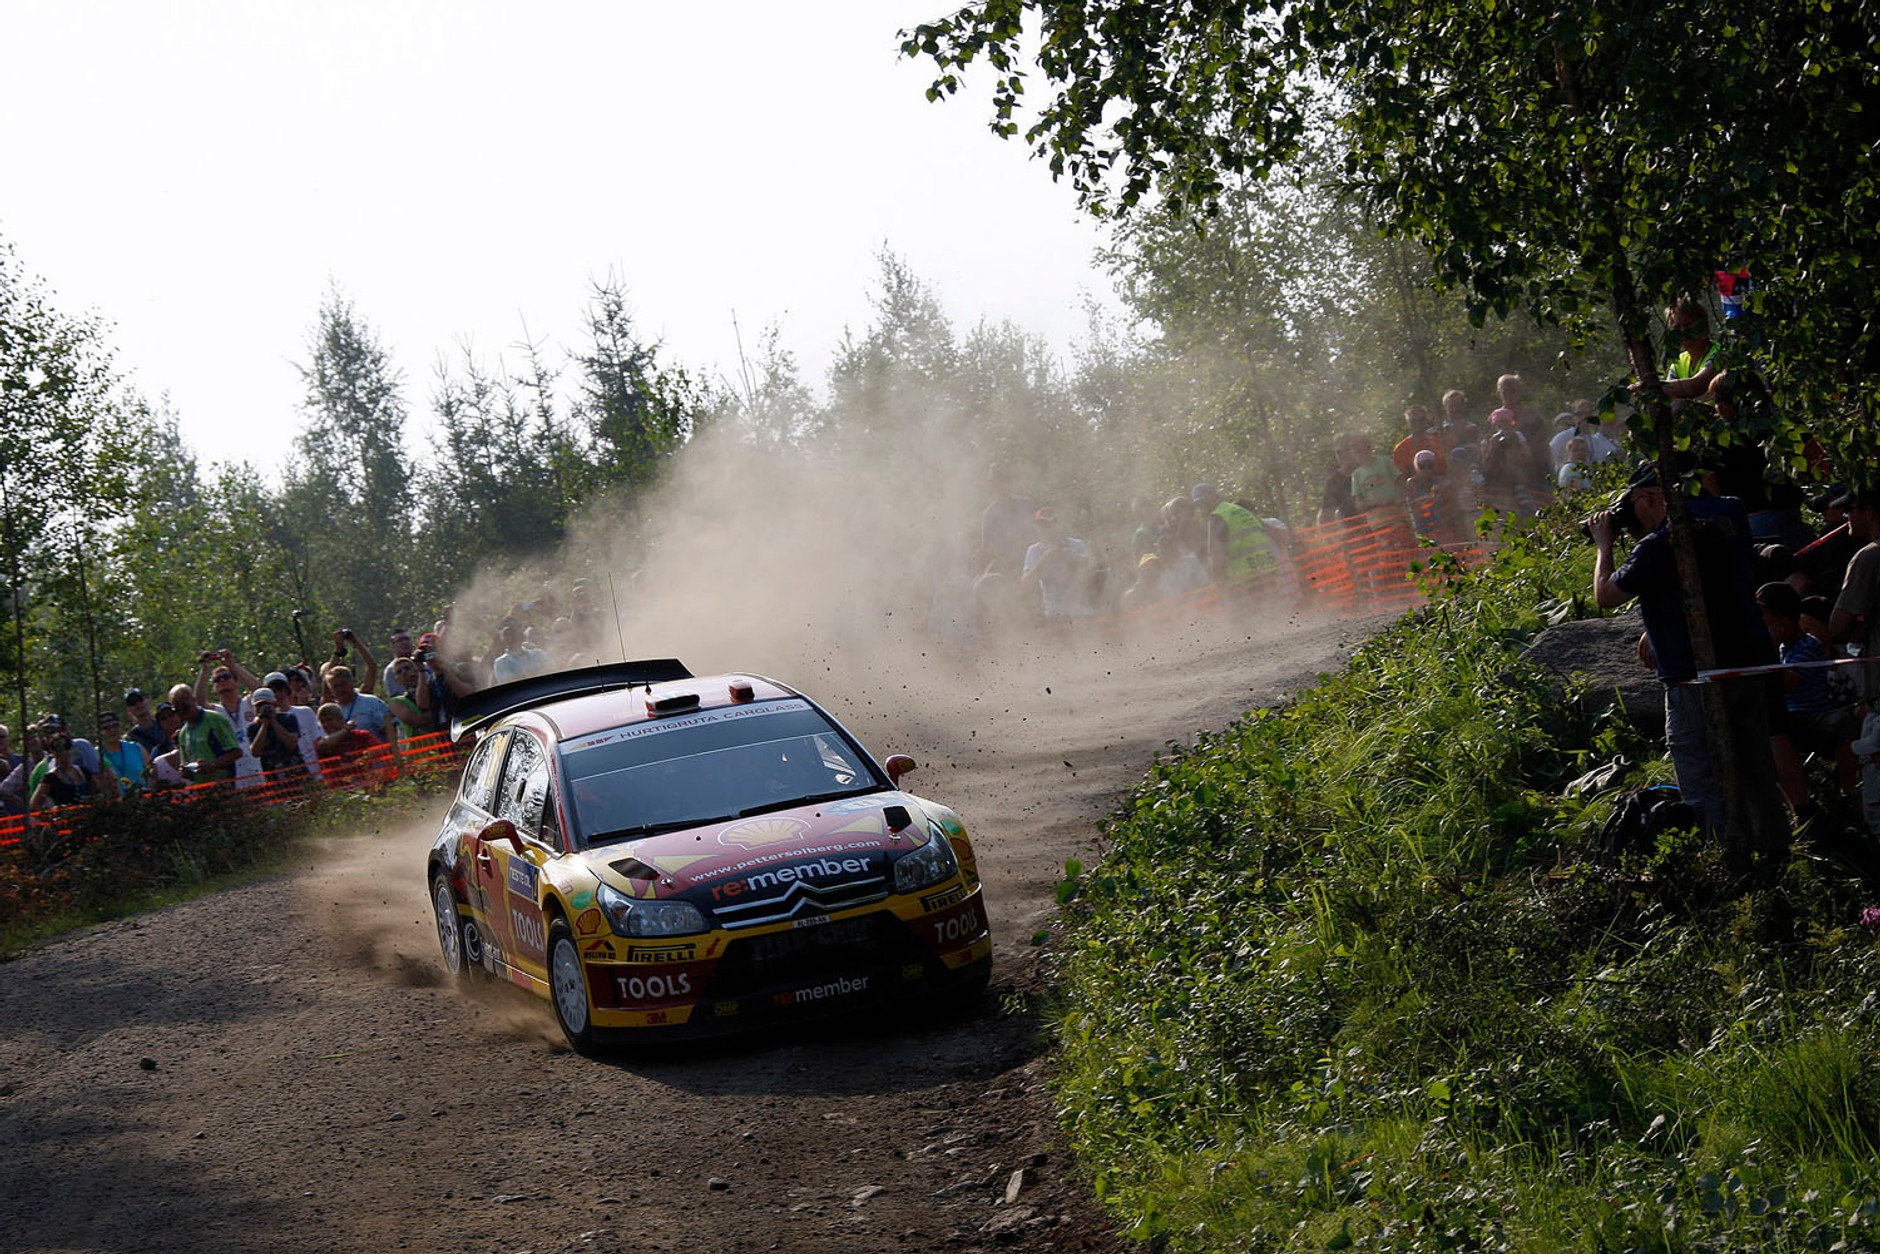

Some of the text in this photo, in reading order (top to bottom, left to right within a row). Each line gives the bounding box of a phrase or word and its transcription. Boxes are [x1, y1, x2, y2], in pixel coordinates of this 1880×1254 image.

[620, 715, 719, 739] HURTIGRUTA
[724, 703, 804, 720] CARGLASS
[690, 839, 881, 883] www.pettersolberg.com
[711, 857, 872, 901] re:member
[512, 908, 545, 952] TOOLS
[934, 908, 978, 944] TOOLS
[626, 943, 697, 962] PIRELLI
[616, 972, 692, 999] TOOLS
[646, 1012, 668, 1025] 3M
